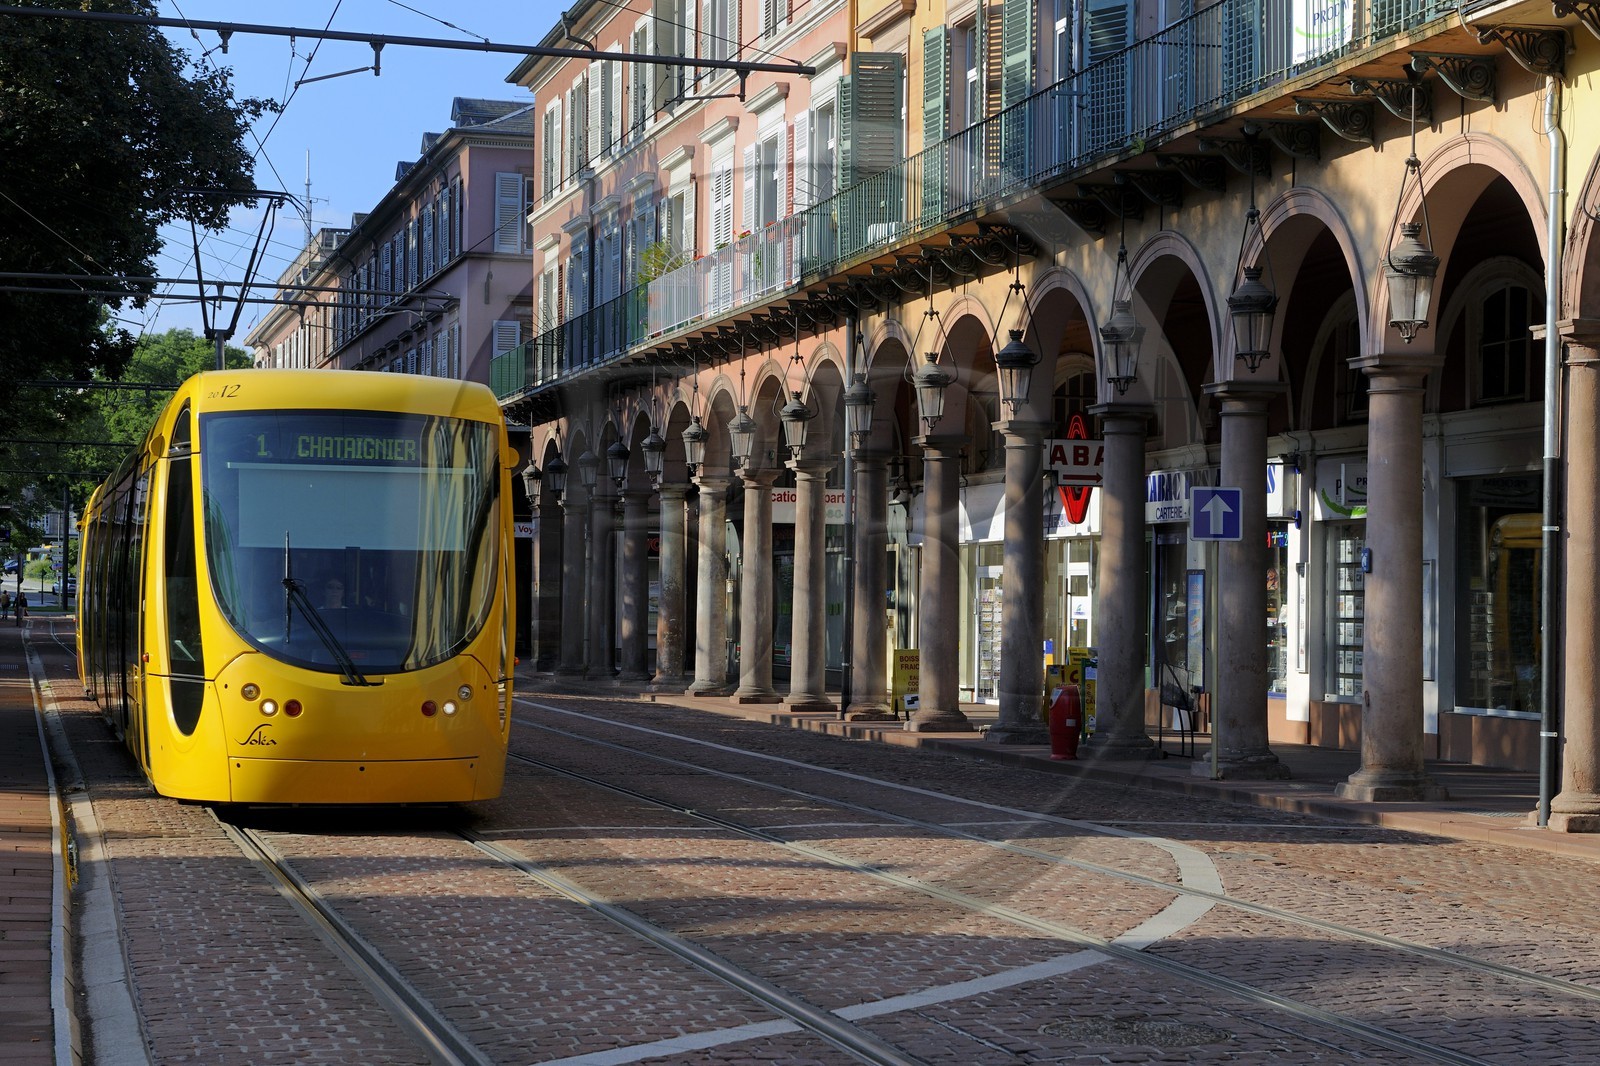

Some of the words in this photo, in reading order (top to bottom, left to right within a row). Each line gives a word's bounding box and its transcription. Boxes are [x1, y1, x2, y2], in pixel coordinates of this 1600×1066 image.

[257, 434, 268, 456] 1
[297, 435, 416, 461] CHATAIGNIER
[1155, 505, 1183, 520] CARTERIE
